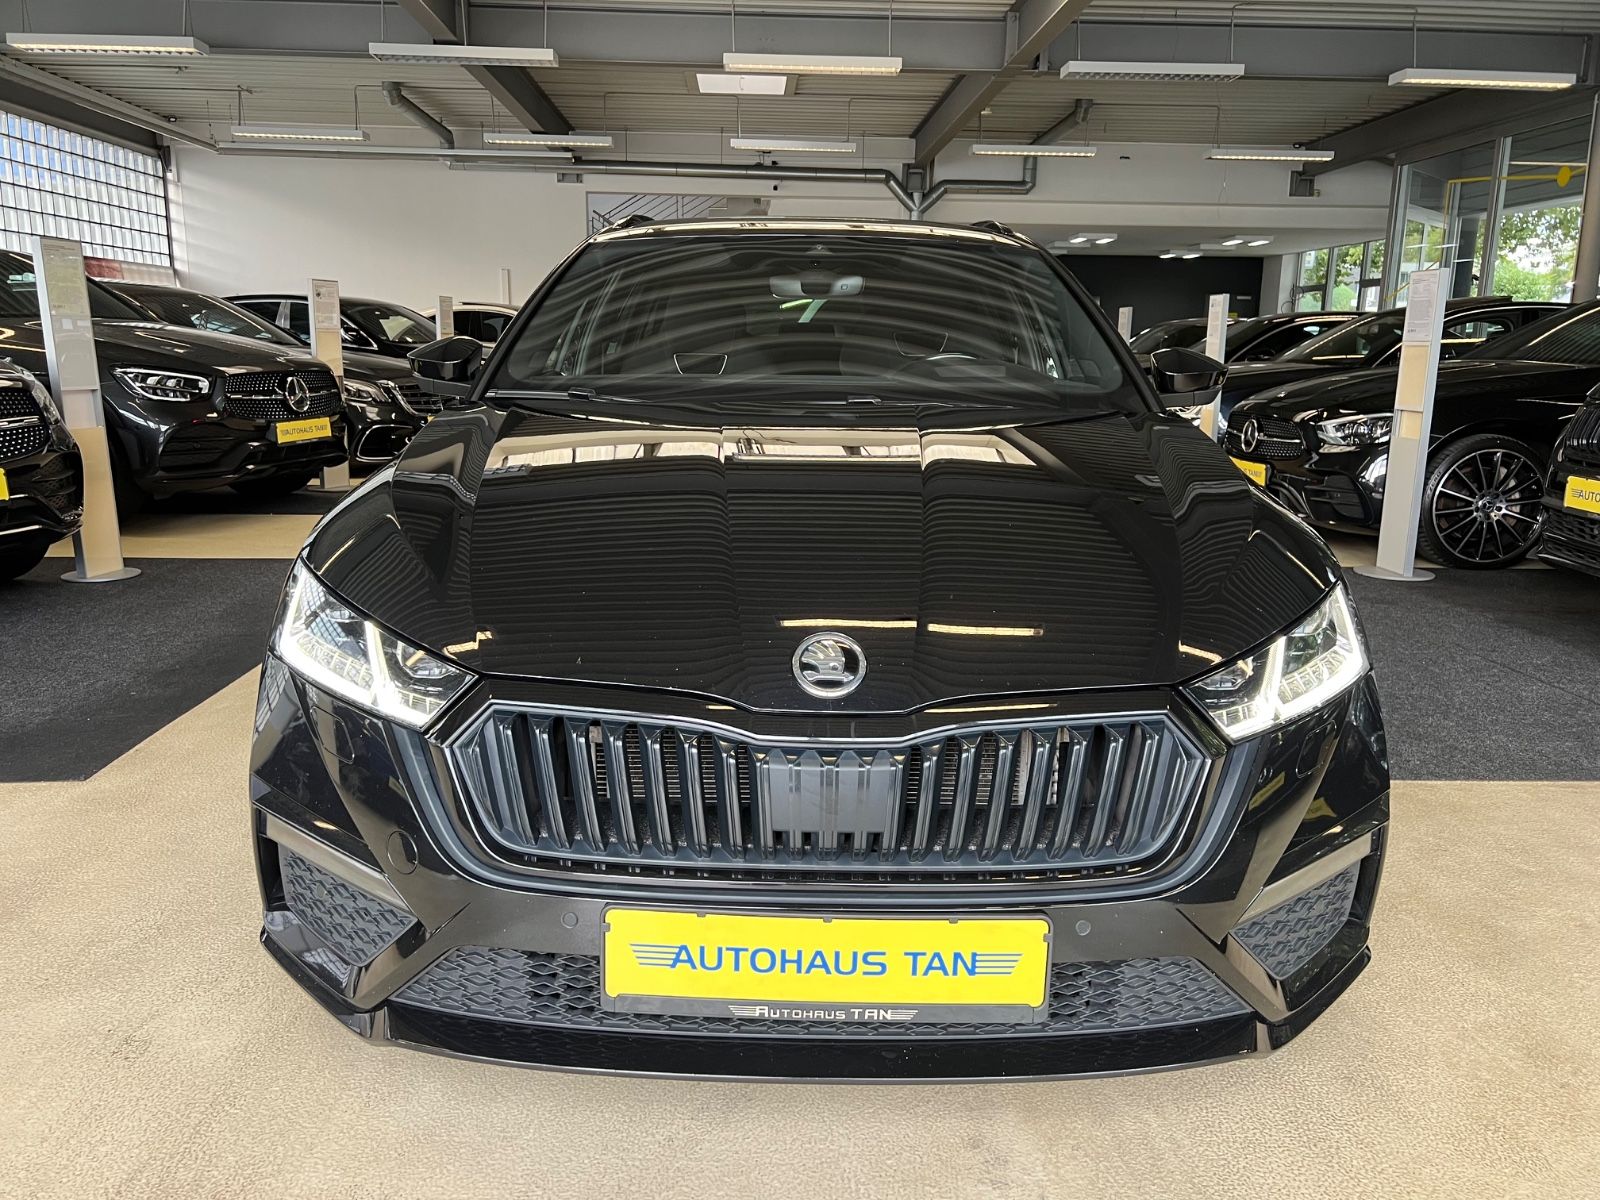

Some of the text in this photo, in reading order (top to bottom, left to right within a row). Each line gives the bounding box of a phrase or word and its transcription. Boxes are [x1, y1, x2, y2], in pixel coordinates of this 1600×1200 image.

[670, 944, 977, 977] AUTOHAUS TAN
[850, 1008, 892, 1020] TAN
